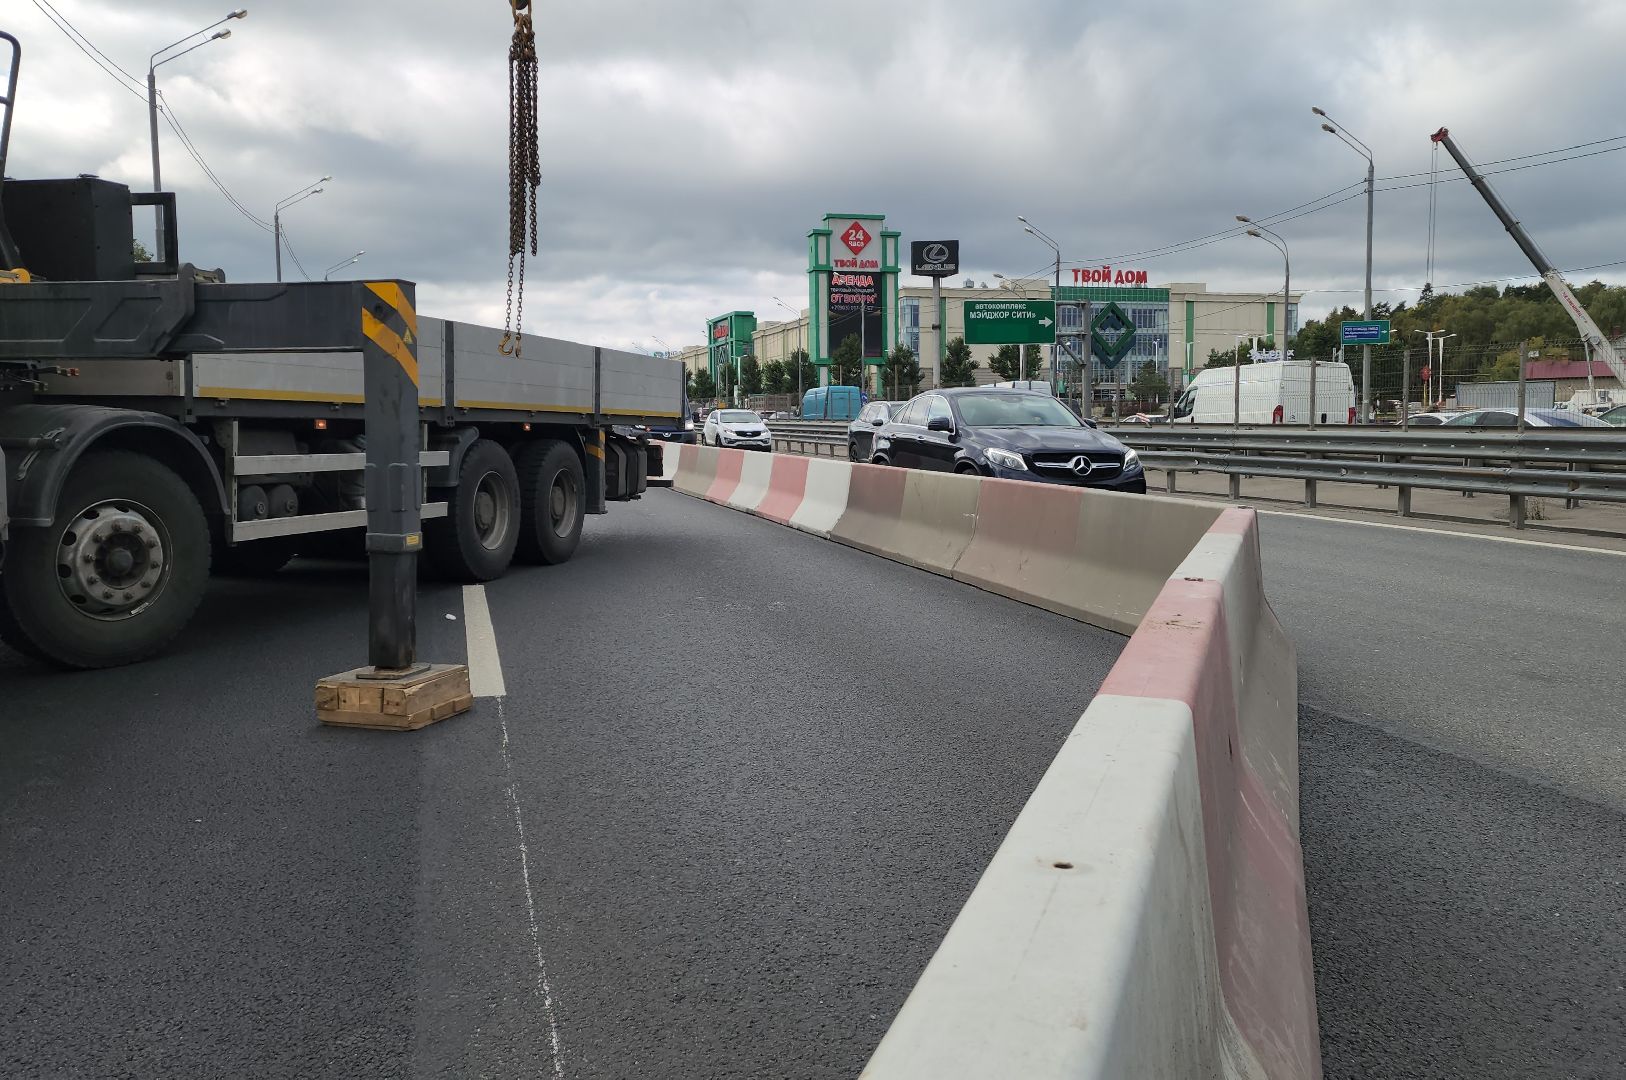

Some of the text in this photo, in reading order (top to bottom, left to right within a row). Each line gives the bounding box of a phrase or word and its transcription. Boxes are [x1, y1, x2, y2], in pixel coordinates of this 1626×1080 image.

[848, 229, 864, 241] 24
[834, 257, 879, 269] ТВОЙ ДОМ
[832, 274, 874, 287] АРЕНДА
[1072, 265, 1148, 284] ТВОЙ ДОМ
[831, 293, 843, 304] ОТ
[969, 310, 1036, 319] МЭЙДЖОР СИТИ»
